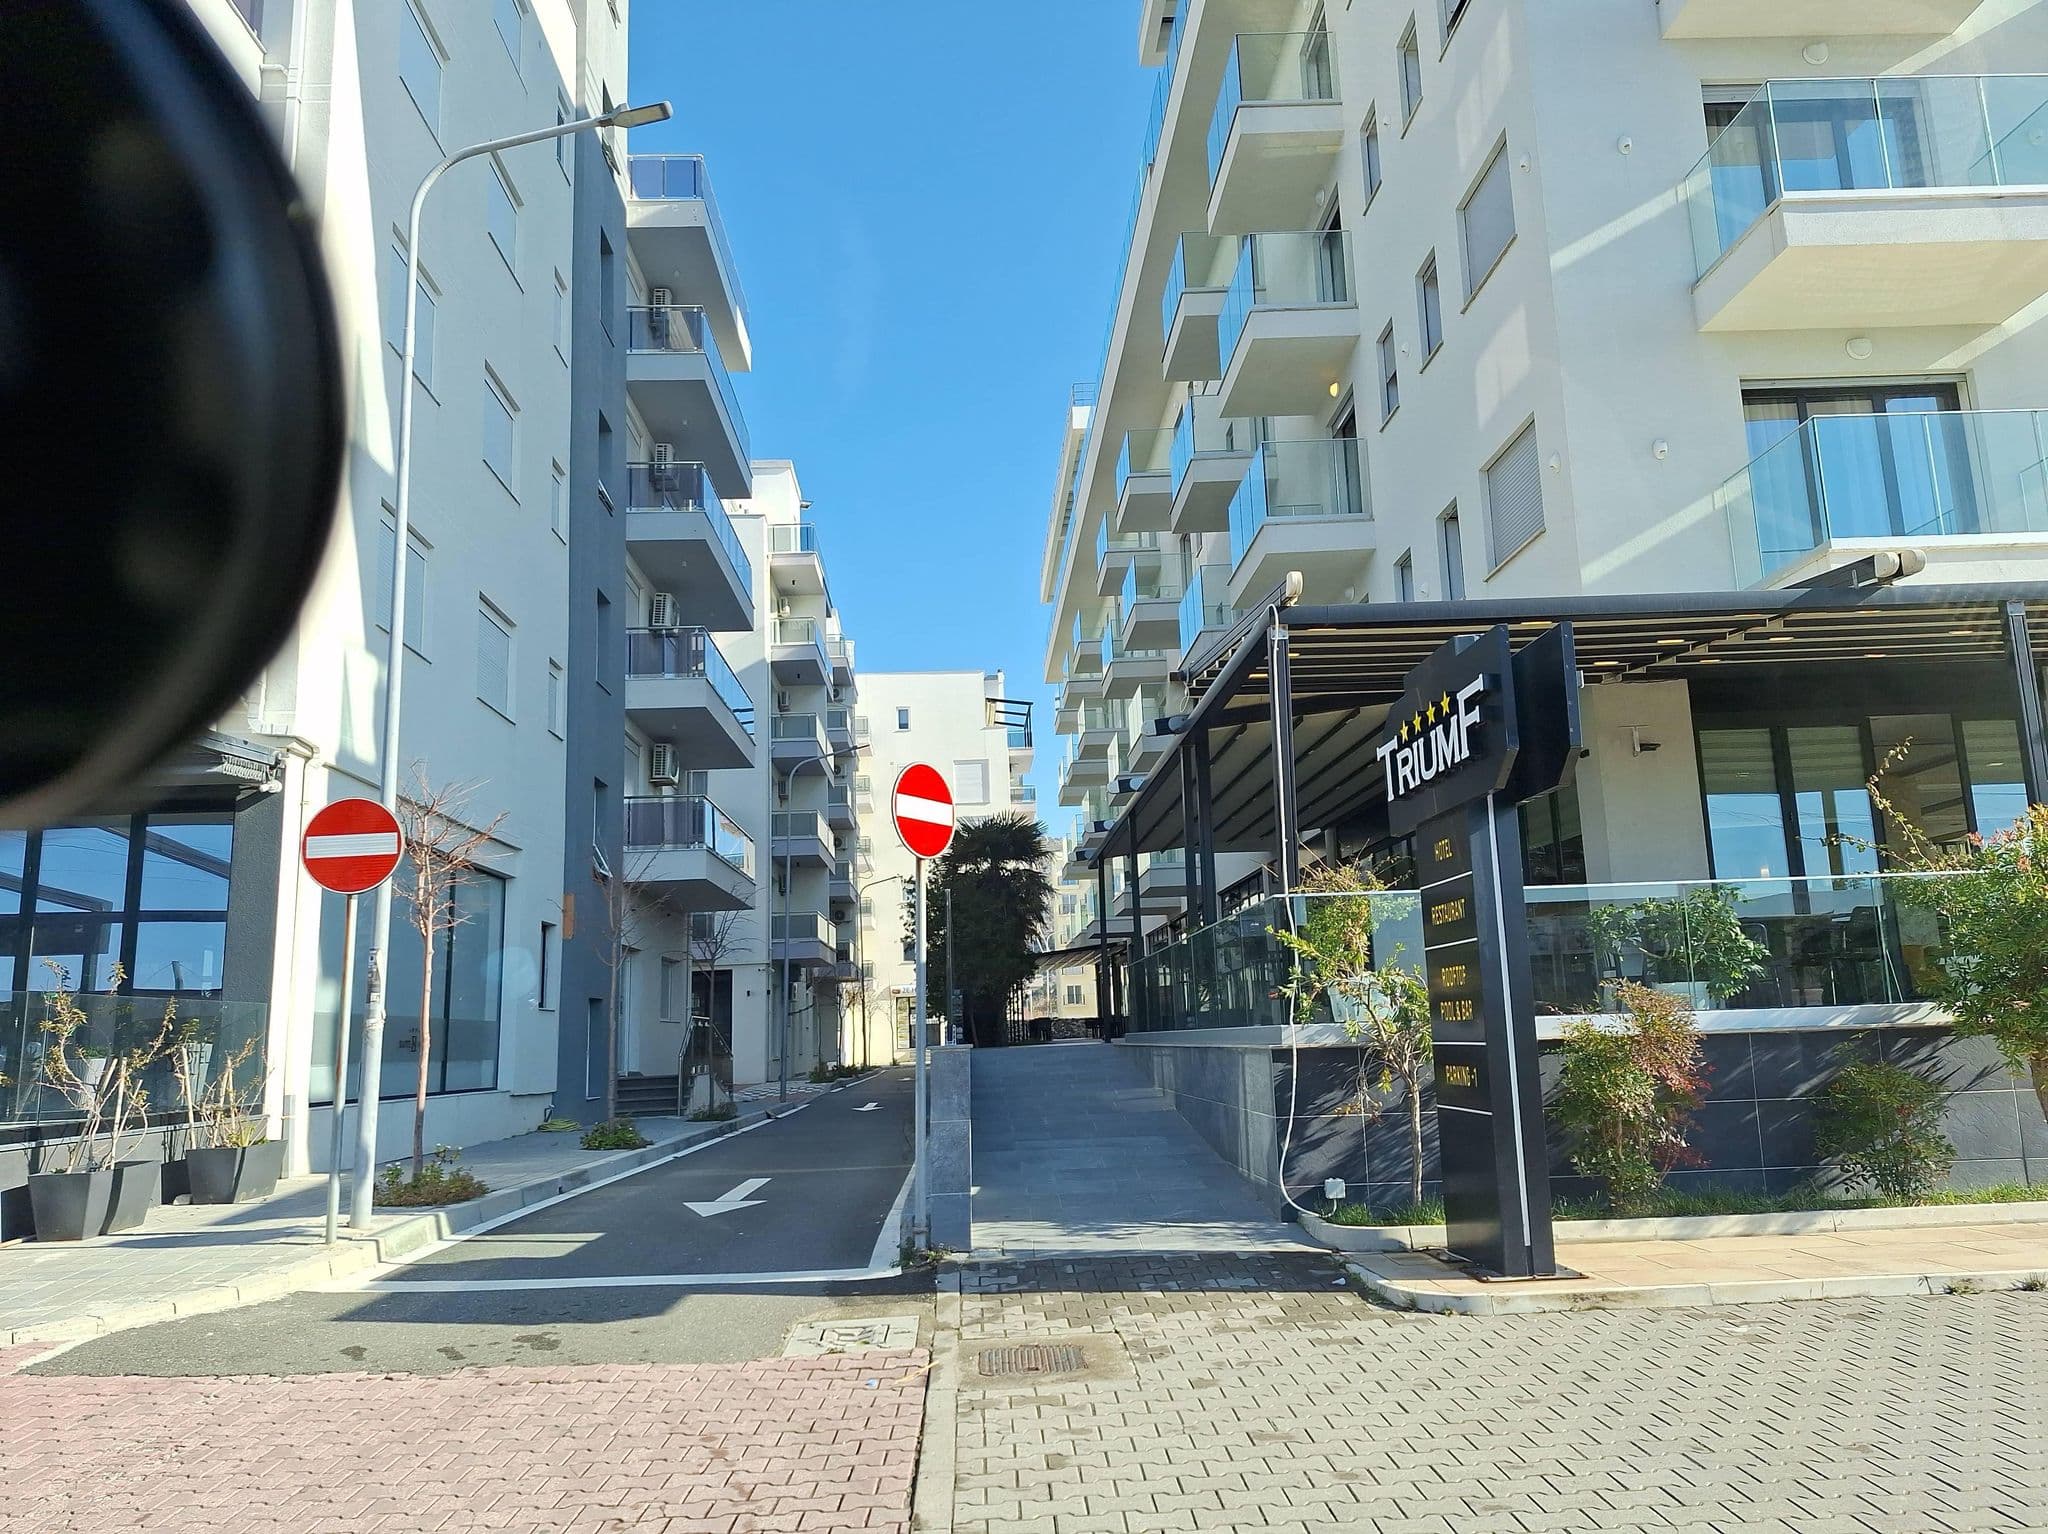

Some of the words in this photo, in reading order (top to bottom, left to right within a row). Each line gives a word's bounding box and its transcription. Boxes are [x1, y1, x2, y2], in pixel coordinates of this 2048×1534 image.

[1376, 672, 1484, 802] TRIUMF
[1434, 838, 1453, 862] HOTEL
[1431, 898, 1466, 926] RESTAURANT
[1441, 964, 1466, 988] ROOFTOP
[1440, 1001, 1455, 1021] POOL
[1455, 1000, 1461, 1021] &
[1461, 999, 1473, 1021] BAR
[1446, 1065, 1471, 1087] PARKING
